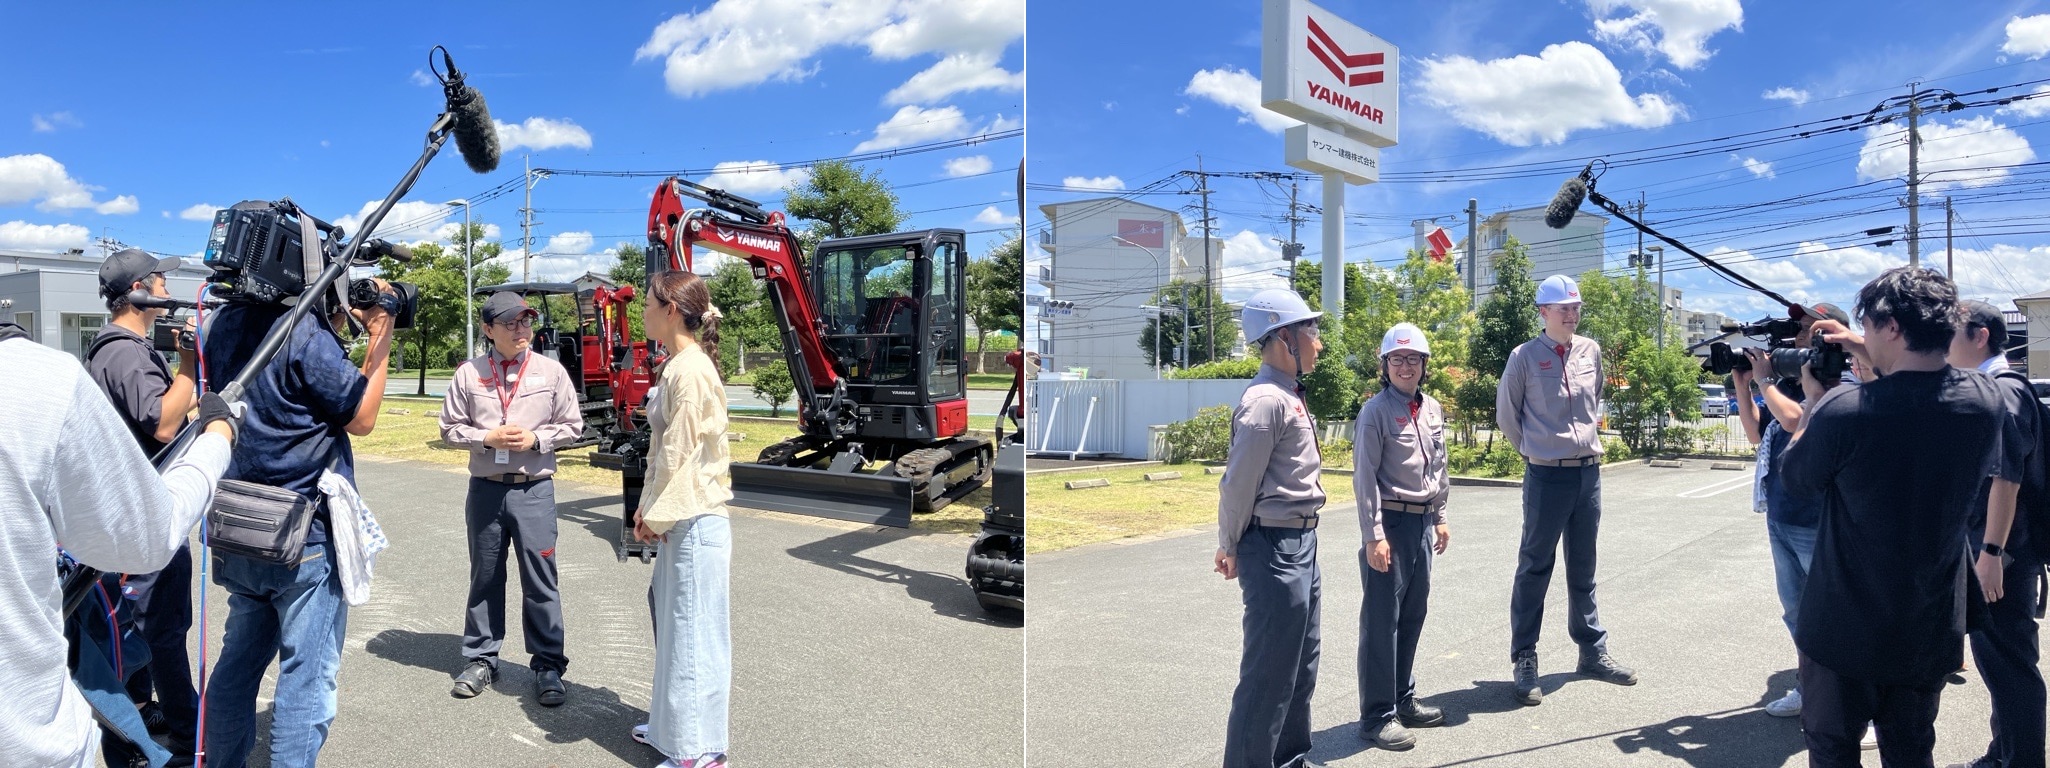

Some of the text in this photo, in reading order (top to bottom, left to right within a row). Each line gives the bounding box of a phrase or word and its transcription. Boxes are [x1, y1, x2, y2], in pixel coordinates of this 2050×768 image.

[1307, 80, 1384, 125] YANMAR
[1312, 139, 1376, 169] ヤンマー建機株式会社
[736, 231, 781, 253] YANMAR
